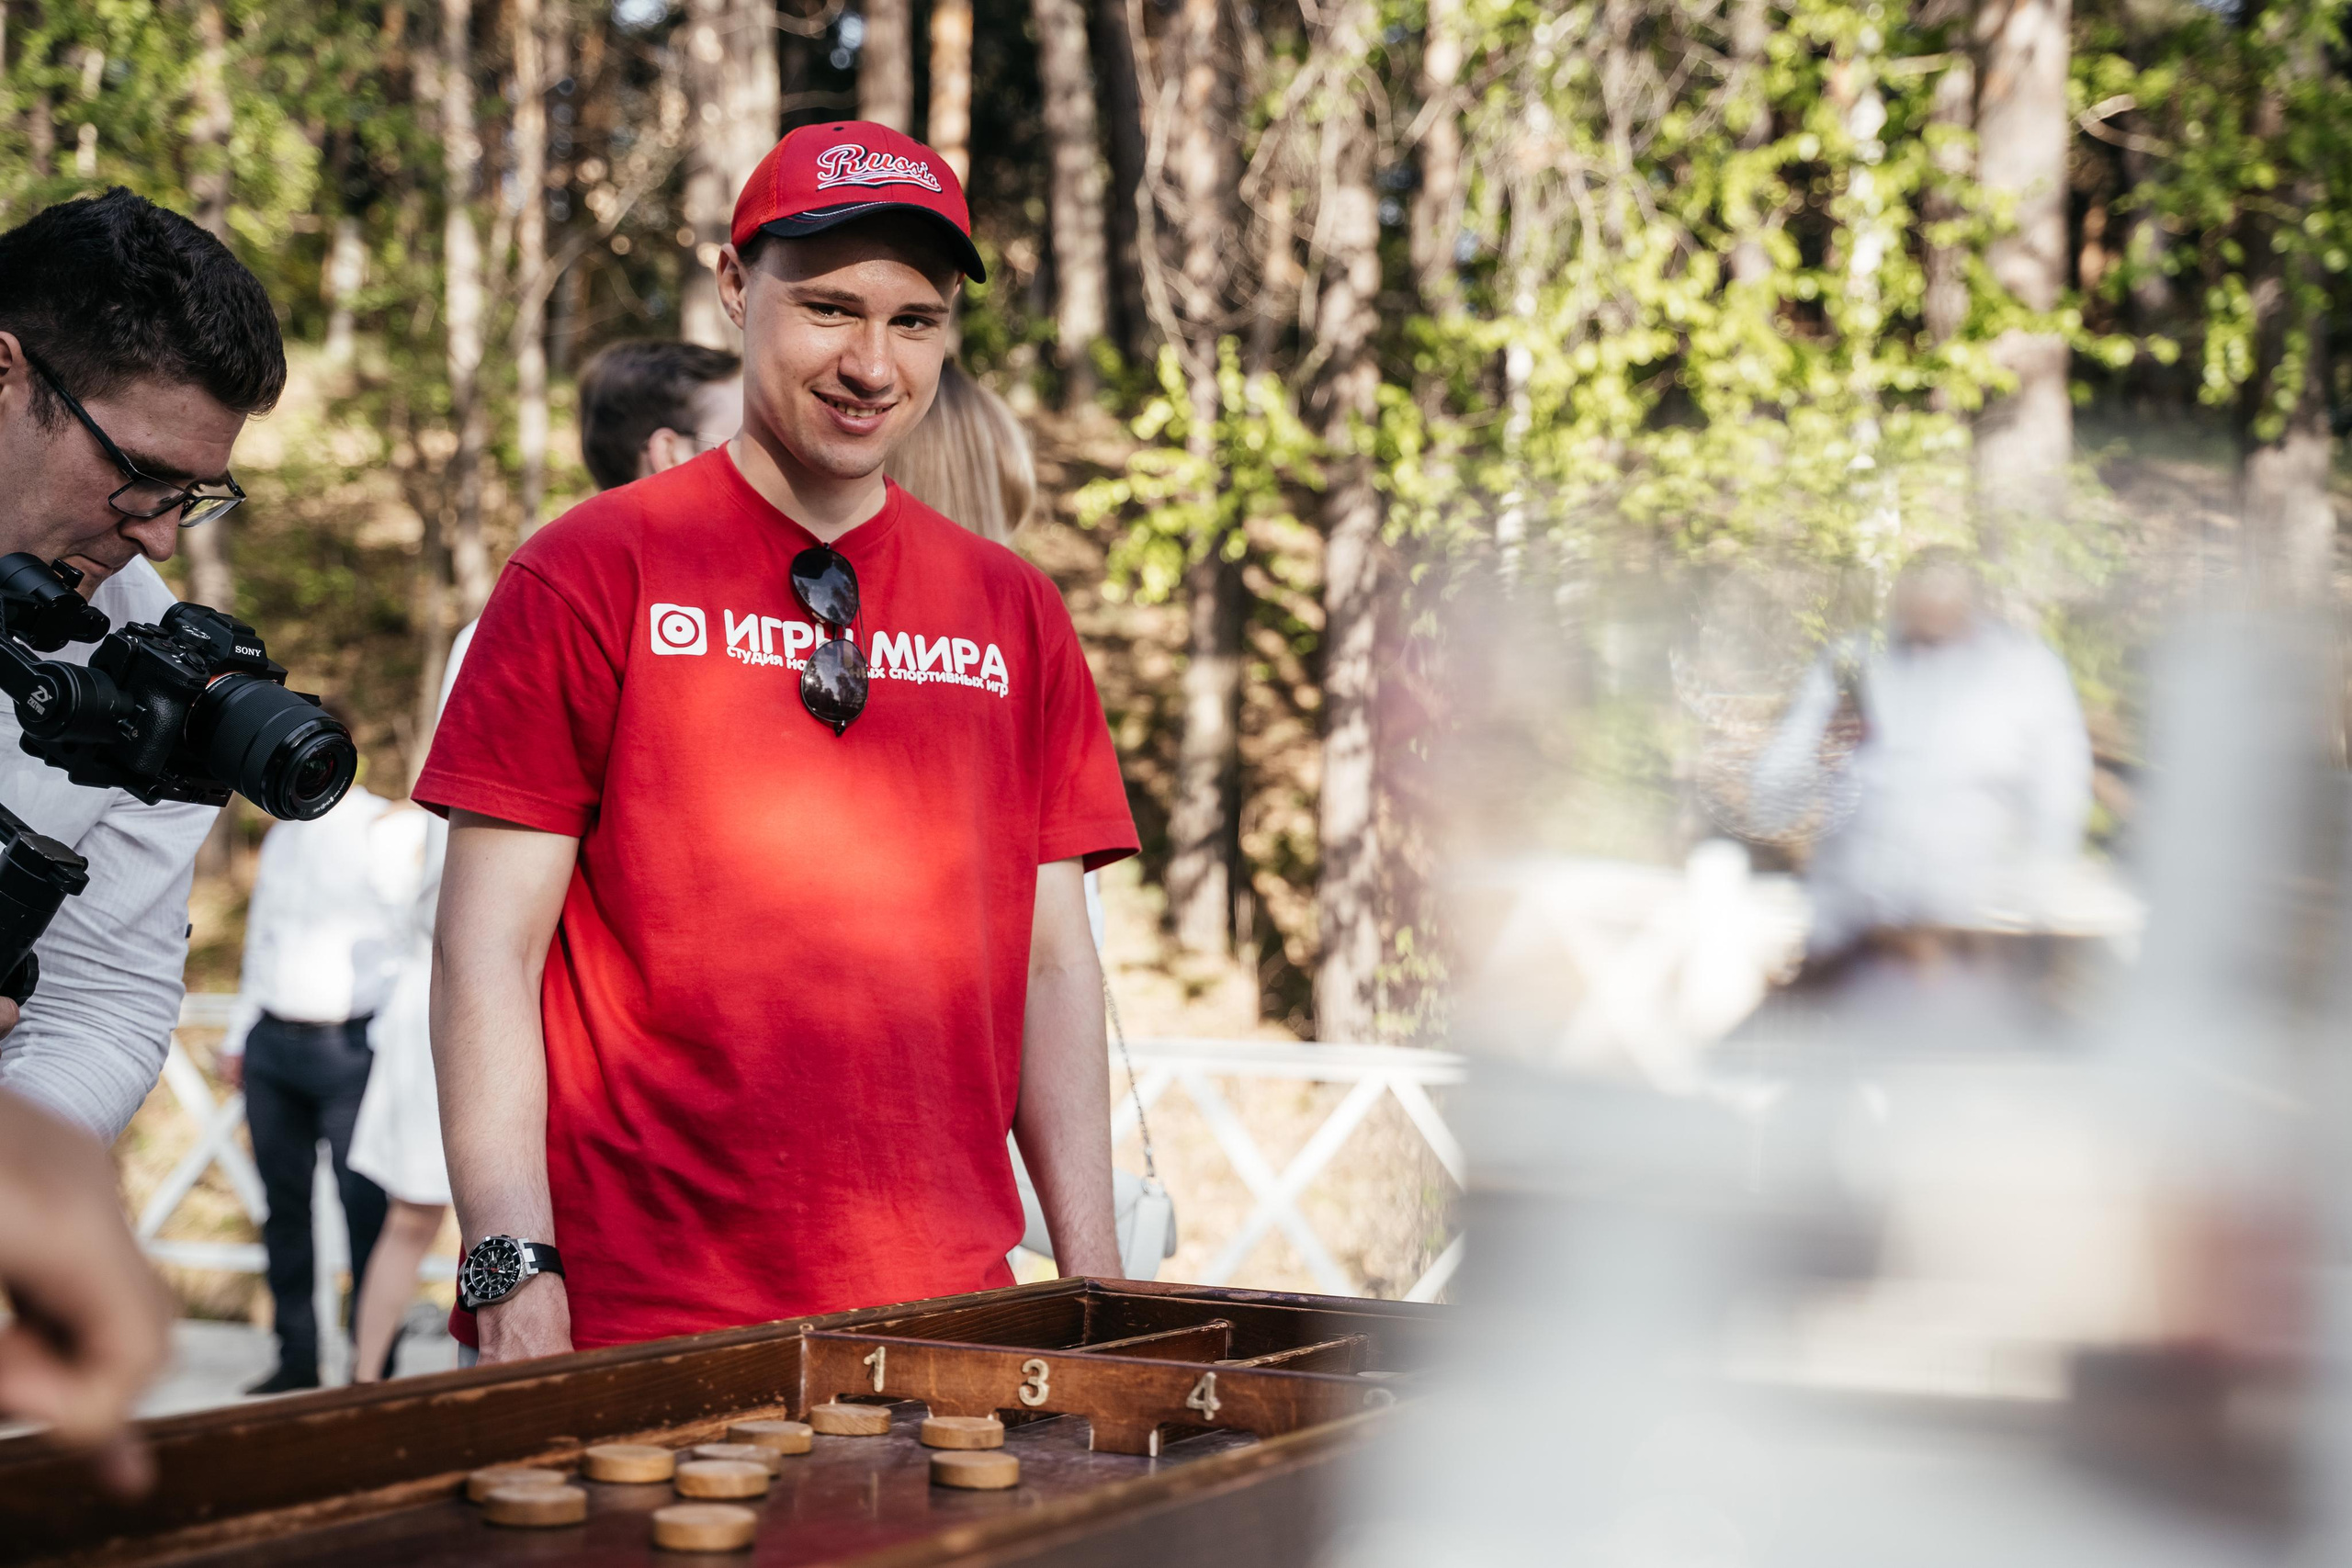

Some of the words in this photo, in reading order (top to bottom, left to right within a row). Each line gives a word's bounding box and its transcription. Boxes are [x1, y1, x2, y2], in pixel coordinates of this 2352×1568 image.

[234, 645, 262, 658] SONY
[726, 646, 784, 668] студия
[888, 667, 984, 690] спортивных
[986, 680, 1009, 698] игр
[870, 630, 1009, 685] МИРА
[864, 1346, 886, 1393] 1
[1018, 1358, 1050, 1406] 3
[1185, 1371, 1221, 1421] 4
